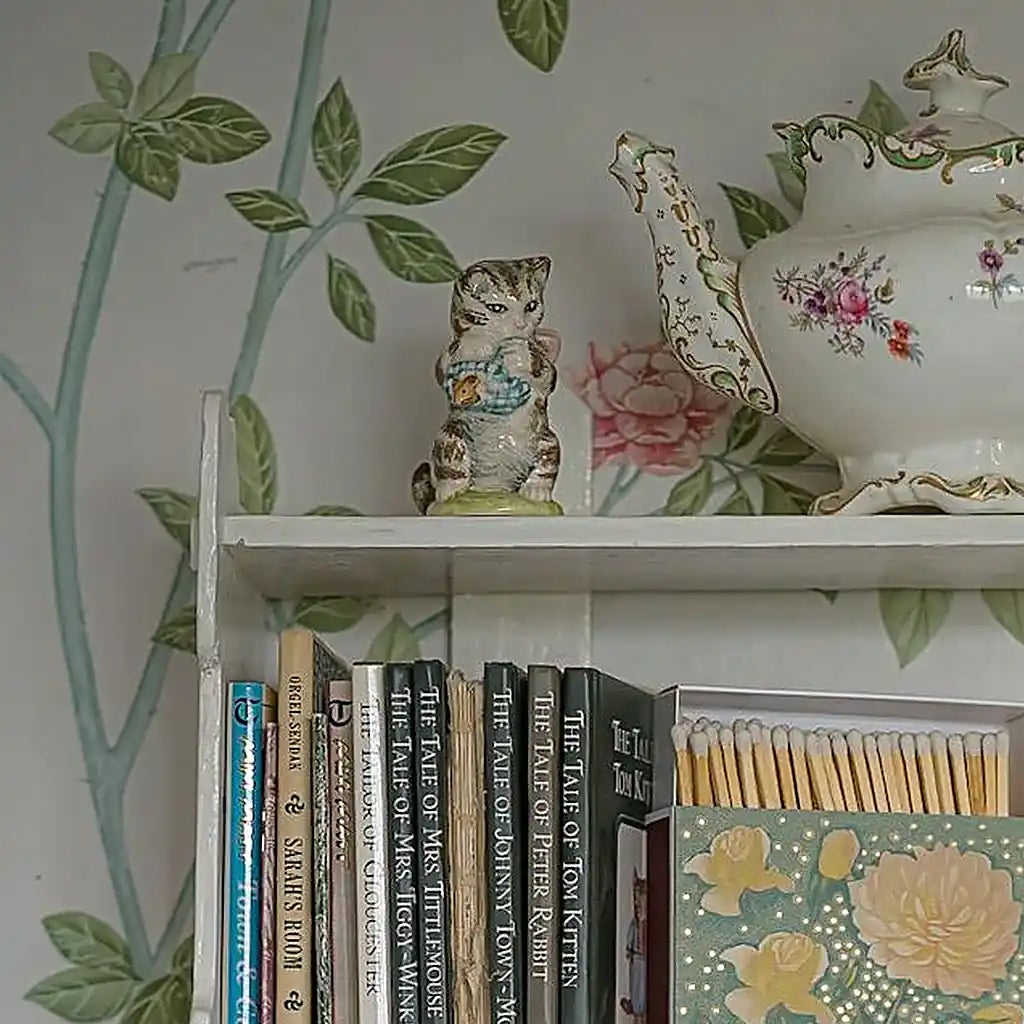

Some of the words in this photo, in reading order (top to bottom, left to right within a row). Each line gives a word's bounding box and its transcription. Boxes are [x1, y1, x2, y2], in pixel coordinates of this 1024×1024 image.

[288, 676, 302, 770] ORGEL-SENDAK
[360, 699, 381, 738] THE
[390, 687, 412, 729] THE
[419, 687, 440, 728] THE
[492, 688, 513, 729] THE
[533, 691, 555, 732] THE
[563, 710, 585, 752] THE
[391, 735, 412, 790] TALE
[419, 733, 441, 787] TALE
[493, 736, 513, 789] TALE
[612, 720, 632, 756] THE
[361, 748, 380, 821] TAILOR
[533, 738, 554, 792] TALE
[563, 759, 584, 813] TALE
[393, 797, 410, 825] OF
[422, 794, 439, 821] OF
[494, 796, 510, 823] OF
[533, 799, 550, 826] OF
[363, 825, 378, 851] OF
[395, 832, 415, 882] MRS.
[422, 827, 443, 875] MRS.
[563, 820, 580, 849] OF
[283, 837, 303, 912] SARAH'S
[494, 828, 514, 915] JOHNNY
[532, 832, 553, 898] PETER
[563, 857, 584, 899] TOM
[283, 920, 303, 970] ROOM
[363, 859, 381, 997] GLOUCESTER
[423, 880, 445, 1018] TITTLEMOUSE
[528, 906, 553, 982] RABBIT
[561, 909, 583, 988] KITTEN
